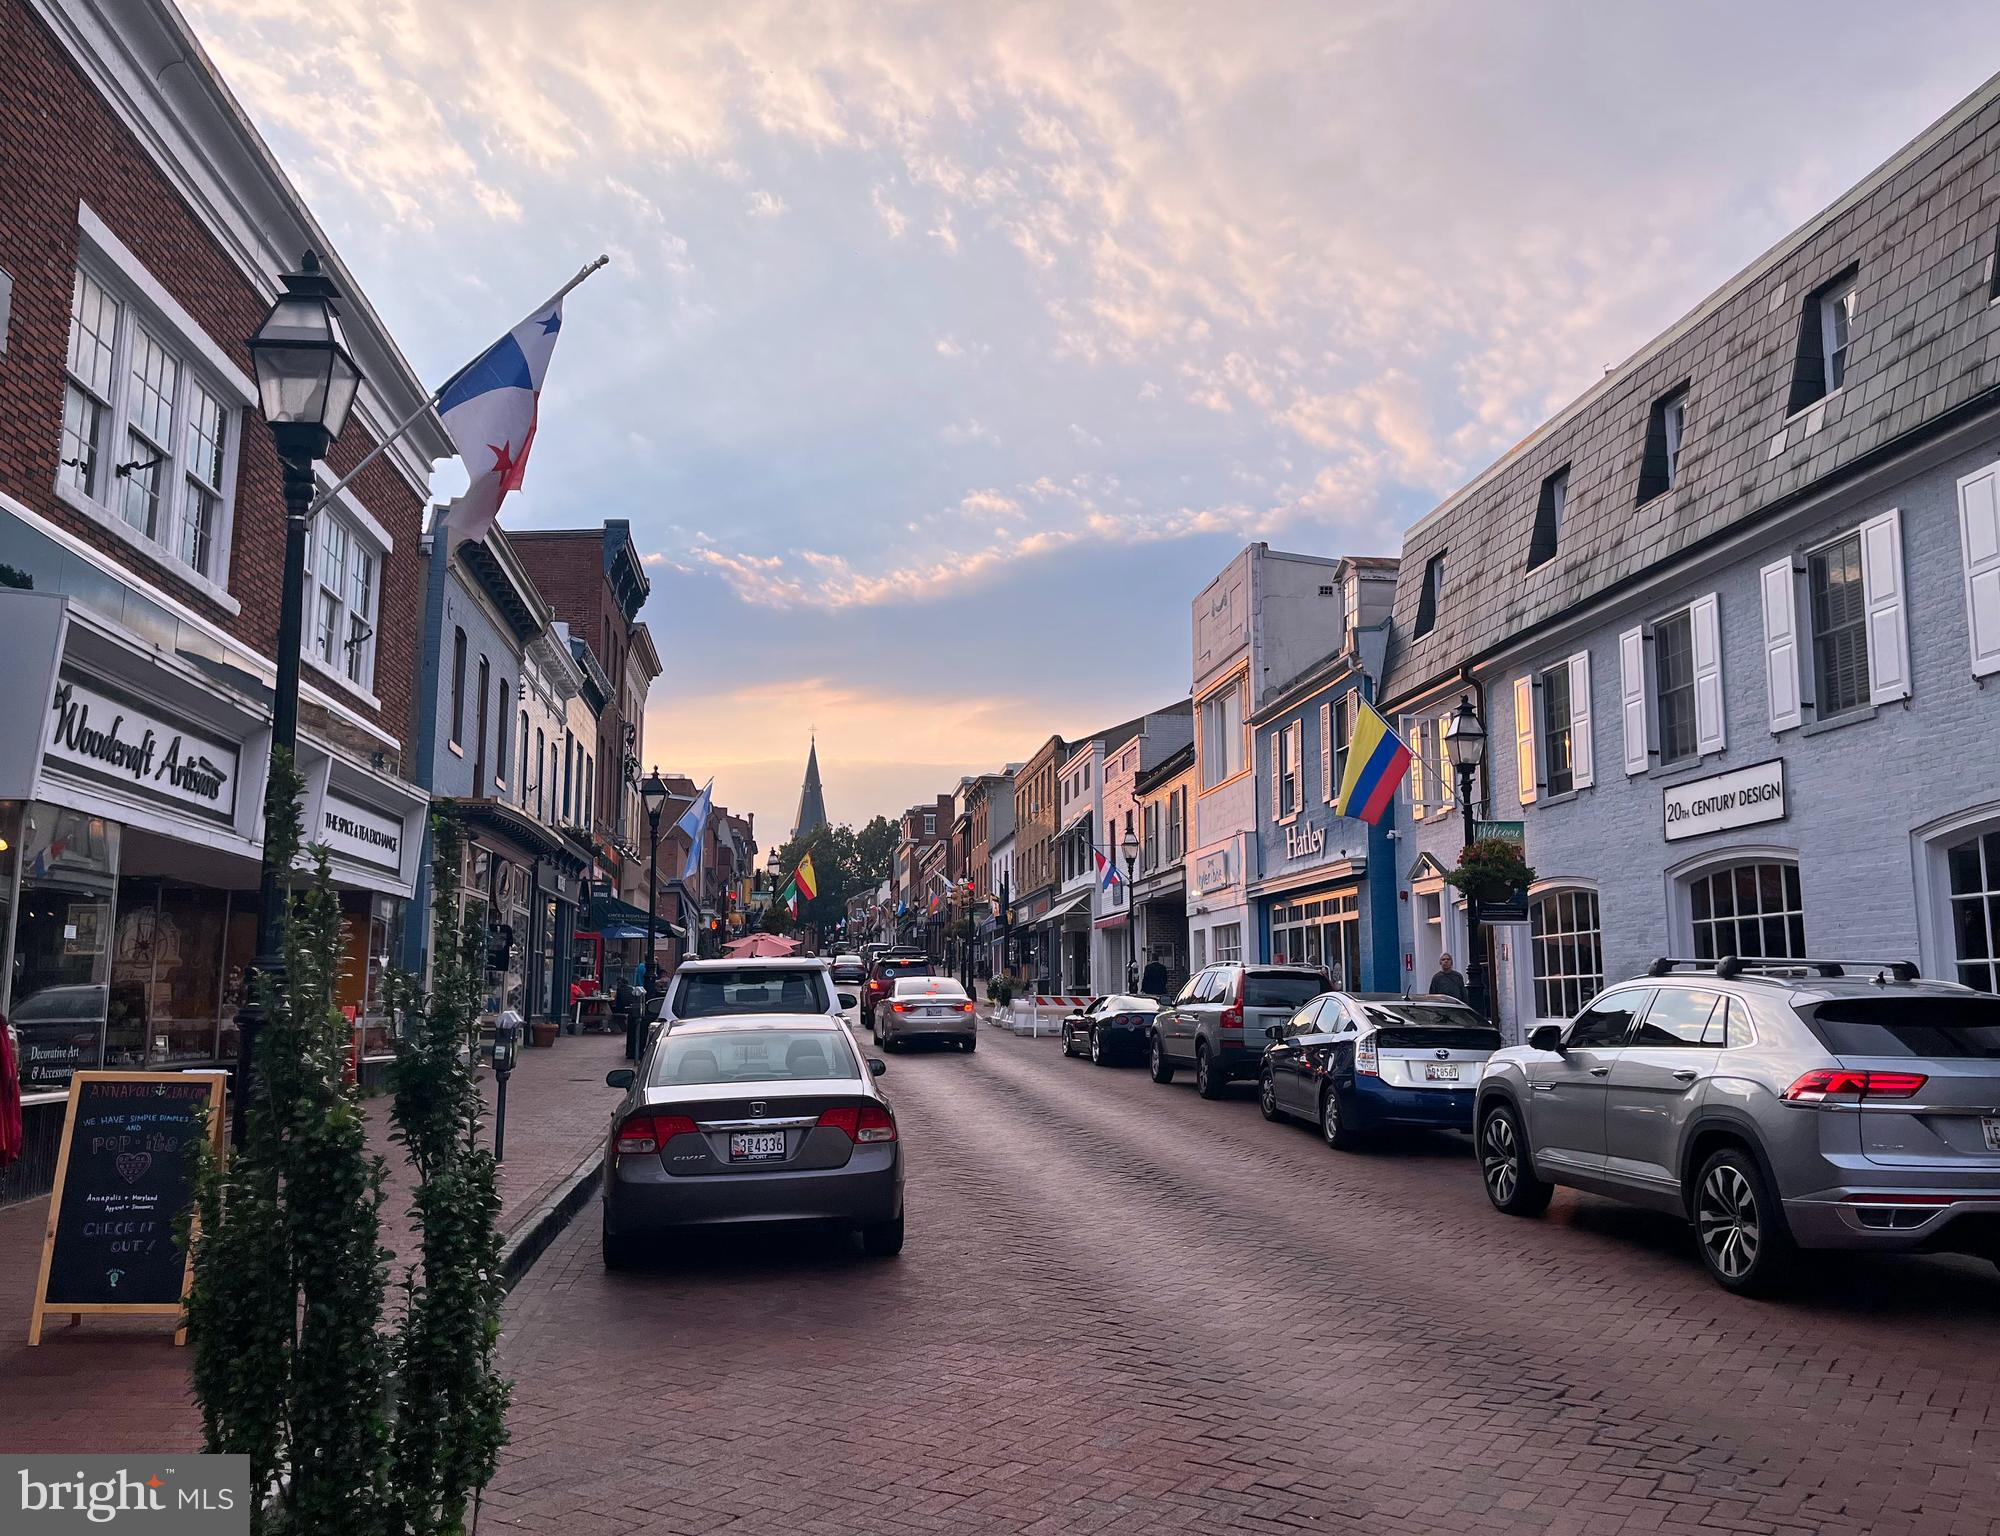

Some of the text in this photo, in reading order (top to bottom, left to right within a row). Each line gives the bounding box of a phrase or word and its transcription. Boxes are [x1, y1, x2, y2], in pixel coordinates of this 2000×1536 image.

[53, 700, 221, 800] Woodcraft Artisans
[1691, 792, 1736, 817] CENTURY
[1739, 781, 1780, 806] DESIGN
[325, 812, 338, 831] THE
[338, 818, 355, 837] SPICE
[359, 825, 369, 842] TEA
[369, 828, 398, 853] EXCHANGE
[1477, 822, 1521, 840] Welcome
[1285, 820, 1325, 860] Hatley
[31, 1045, 80, 1061] Decorative Art
[31, 1066, 39, 1080] &
[83, 1114, 189, 1126] WE HAVE SIMPLE DIMPLES
[125, 1124, 142, 1132] AND
[86, 1193, 121, 1202] Annapolis
[131, 1194, 158, 1202] Maryland
[83, 1222, 156, 1236] CHECK IT
[110, 1239, 156, 1255] OUT!
